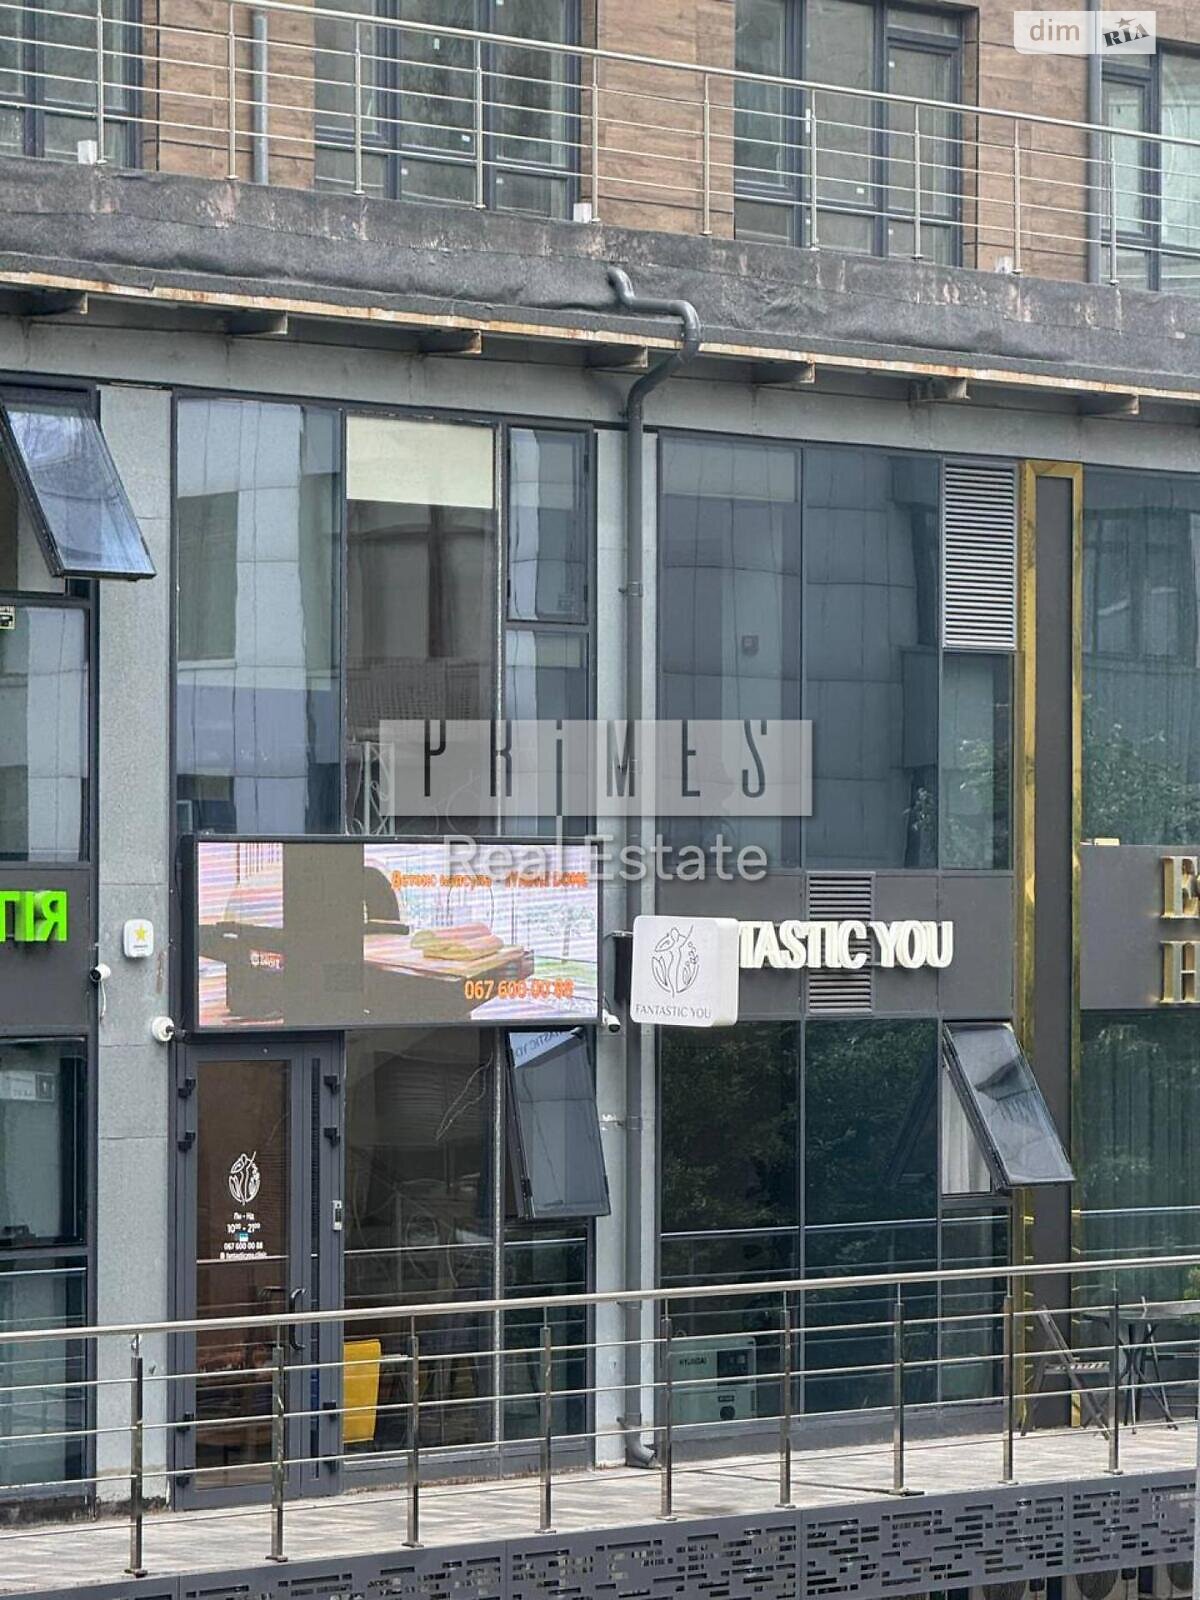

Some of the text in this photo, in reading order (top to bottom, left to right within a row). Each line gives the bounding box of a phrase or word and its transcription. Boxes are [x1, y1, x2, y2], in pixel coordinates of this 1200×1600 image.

[1160, 856, 1200, 919] E
[739, 920, 953, 968] TASTIC YOU
[464, 980, 494, 1000] 067
[635, 1003, 711, 1019] FANTASTIC YOU
